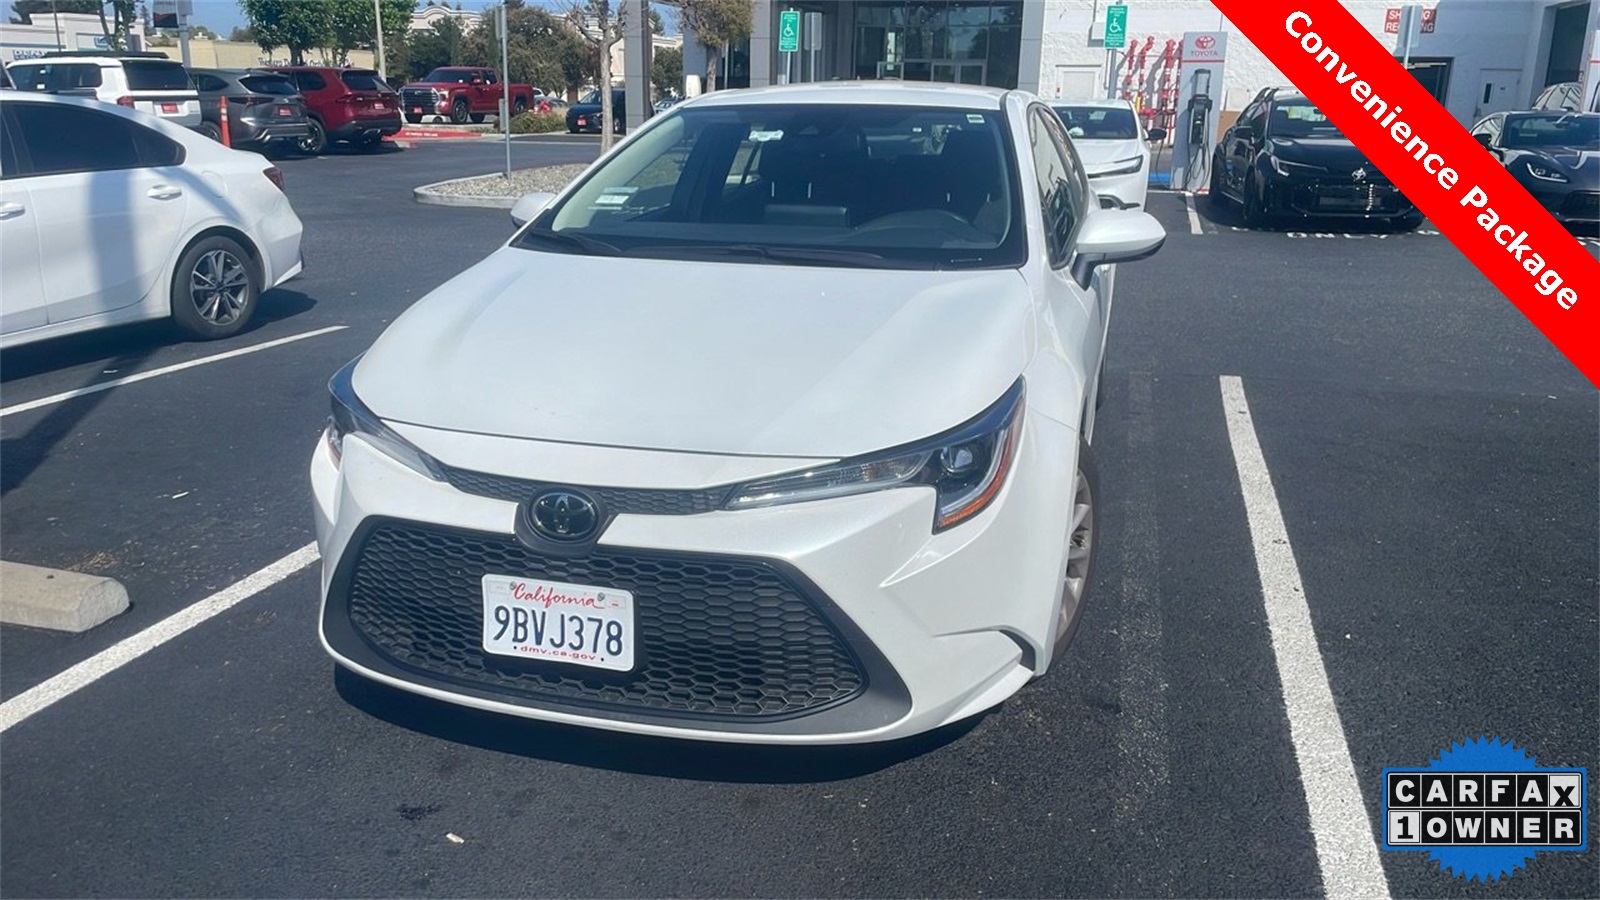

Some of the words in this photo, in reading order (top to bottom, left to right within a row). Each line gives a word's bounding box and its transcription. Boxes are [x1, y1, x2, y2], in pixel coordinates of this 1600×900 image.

[514, 583, 605, 609] California
[493, 605, 623, 656] 9BVJ378
[520, 646, 596, 661] dmv.ca.gov
